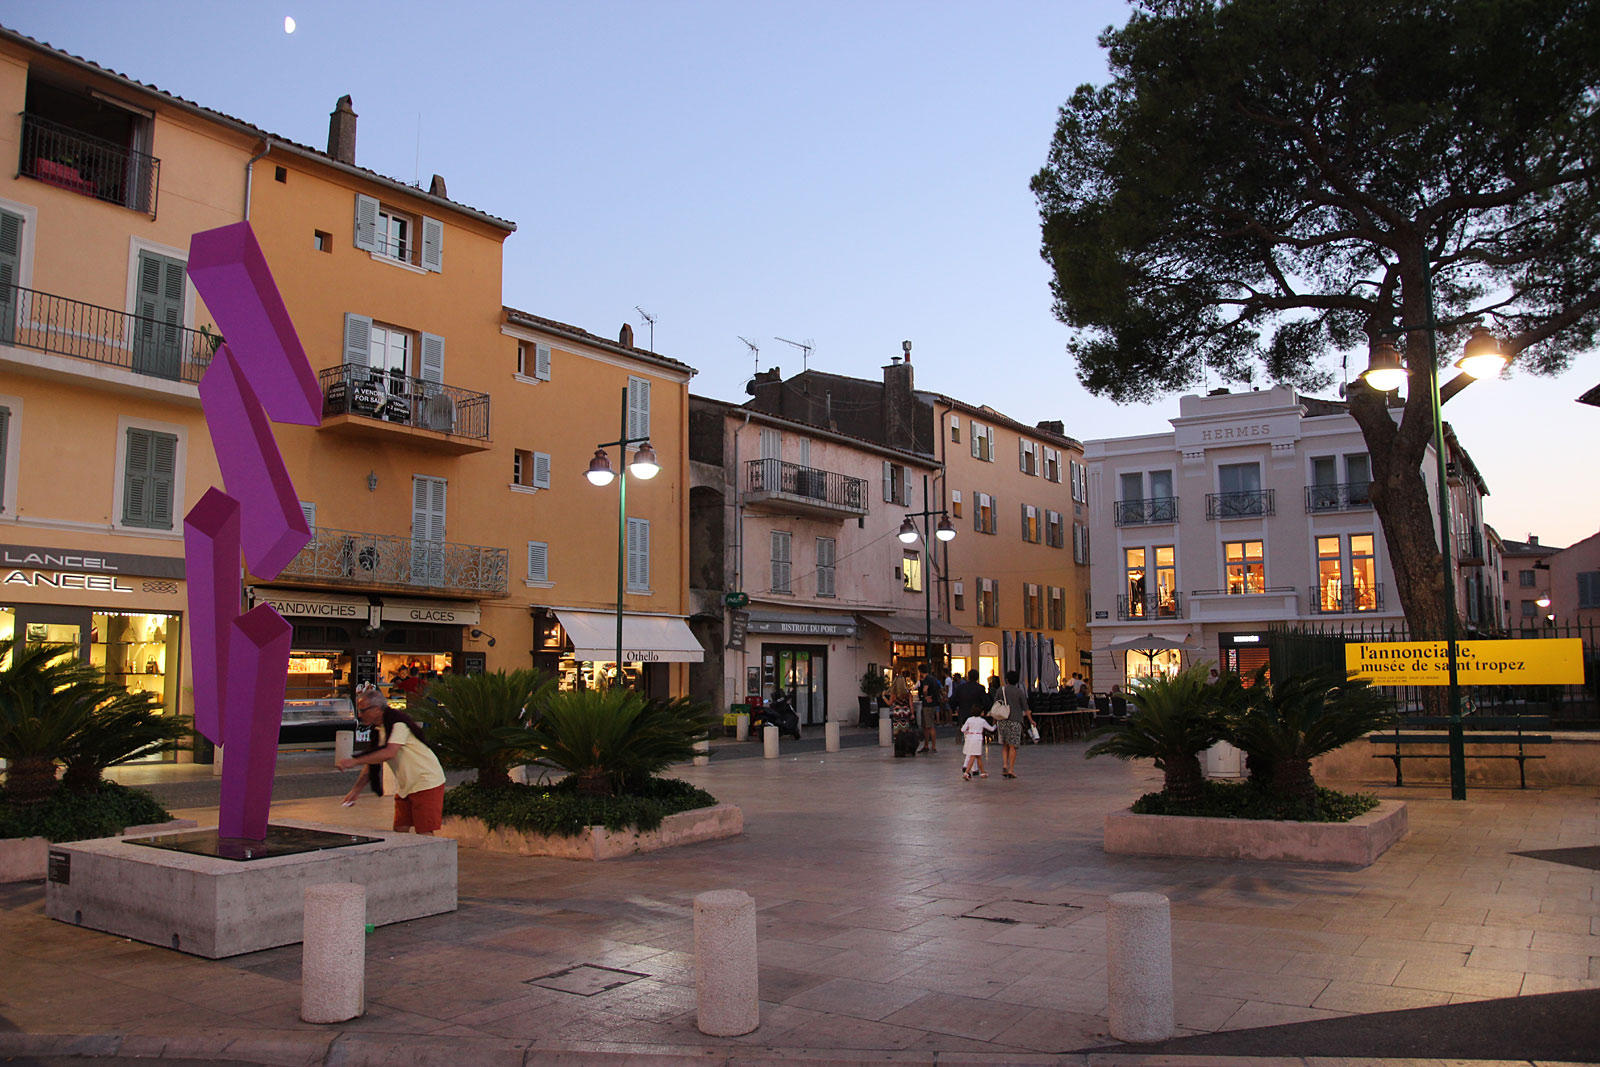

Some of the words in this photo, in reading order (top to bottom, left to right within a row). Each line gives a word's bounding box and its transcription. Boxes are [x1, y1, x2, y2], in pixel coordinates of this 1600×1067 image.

[1202, 424, 1270, 440] HERMES
[4, 551, 118, 570] LANCEL
[0, 570, 134, 592] ANCEL
[268, 602, 356, 616] SANDWICHES
[410, 610, 454, 622] GLACES
[781, 623, 808, 632] BISTROT
[810, 624, 820, 632] DU
[820, 624, 837, 633] PORT
[626, 650, 659, 661] Othello
[1361, 660, 1406, 672] musée
[1412, 660, 1428, 672] de
[1434, 660, 1471, 672] sant
[1475, 660, 1525, 674] tropez
